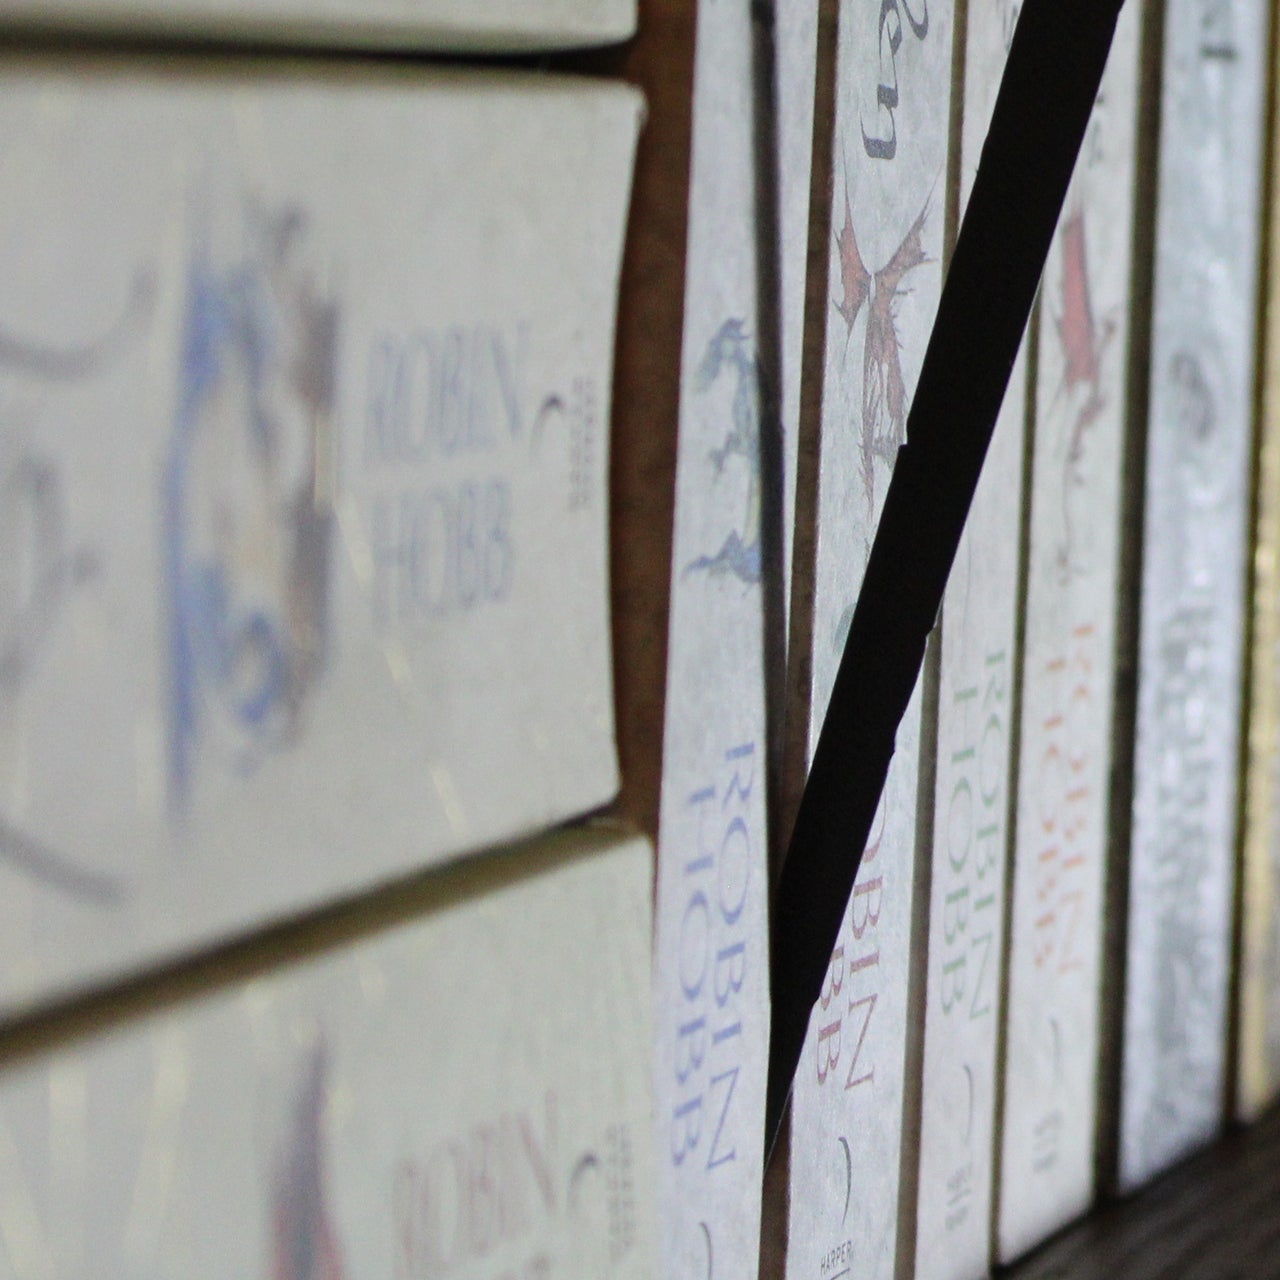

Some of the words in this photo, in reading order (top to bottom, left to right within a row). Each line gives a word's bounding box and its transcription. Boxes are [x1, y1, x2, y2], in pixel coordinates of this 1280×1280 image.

[670, 786, 716, 1168] HOBB
[707, 742, 755, 1171] ROBIN
[845, 786, 887, 1091] BIN
[940, 688, 979, 1018] HOBB
[968, 652, 1006, 1021] ROBIN
